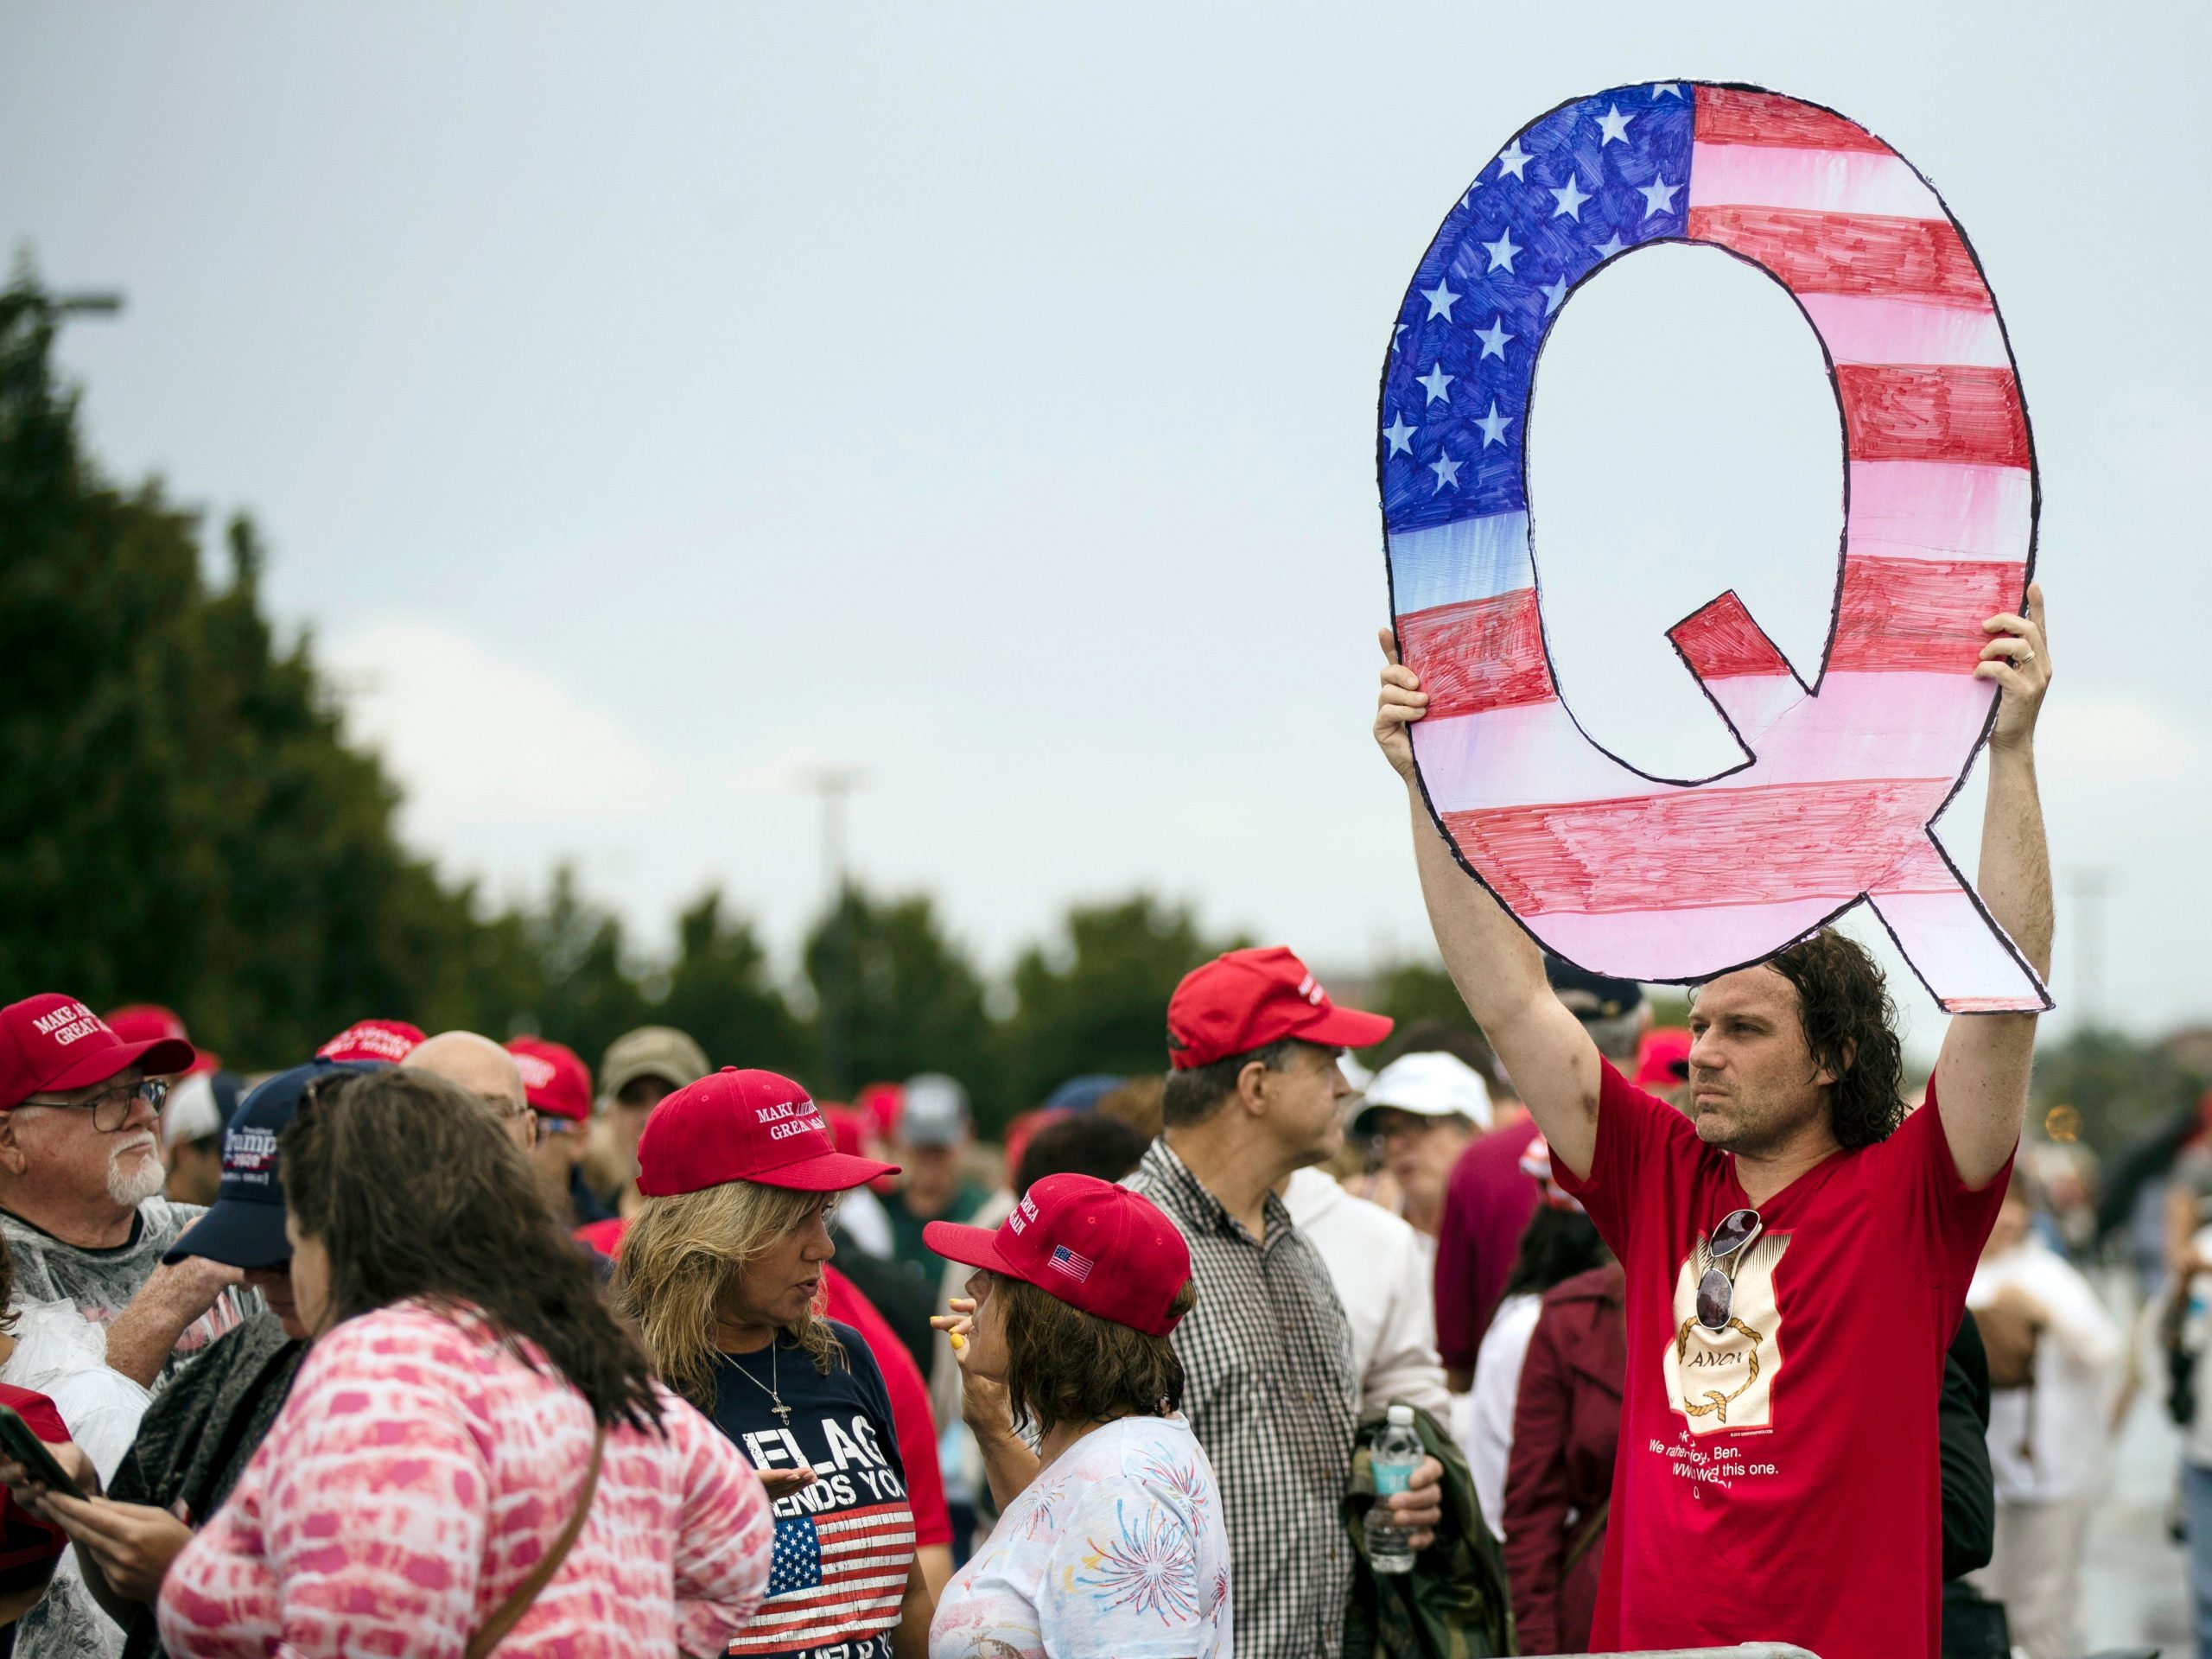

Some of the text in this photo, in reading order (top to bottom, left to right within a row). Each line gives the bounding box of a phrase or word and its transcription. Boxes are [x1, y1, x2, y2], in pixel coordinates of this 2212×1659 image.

[1377, 78, 2056, 1015] Q
[32, 1005, 78, 1036] MAKE
[54, 1017, 99, 1046] GREAT
[755, 1102, 795, 1124] MAKE
[741, 1414, 888, 1476] FLAG
[1649, 1438, 1665, 1454] We
[1722, 1463, 1745, 1477] this
[1749, 1464, 1779, 1475] one.
[1713, 1446, 1742, 1460] Ben.
[770, 1473, 857, 1518] ENDS
